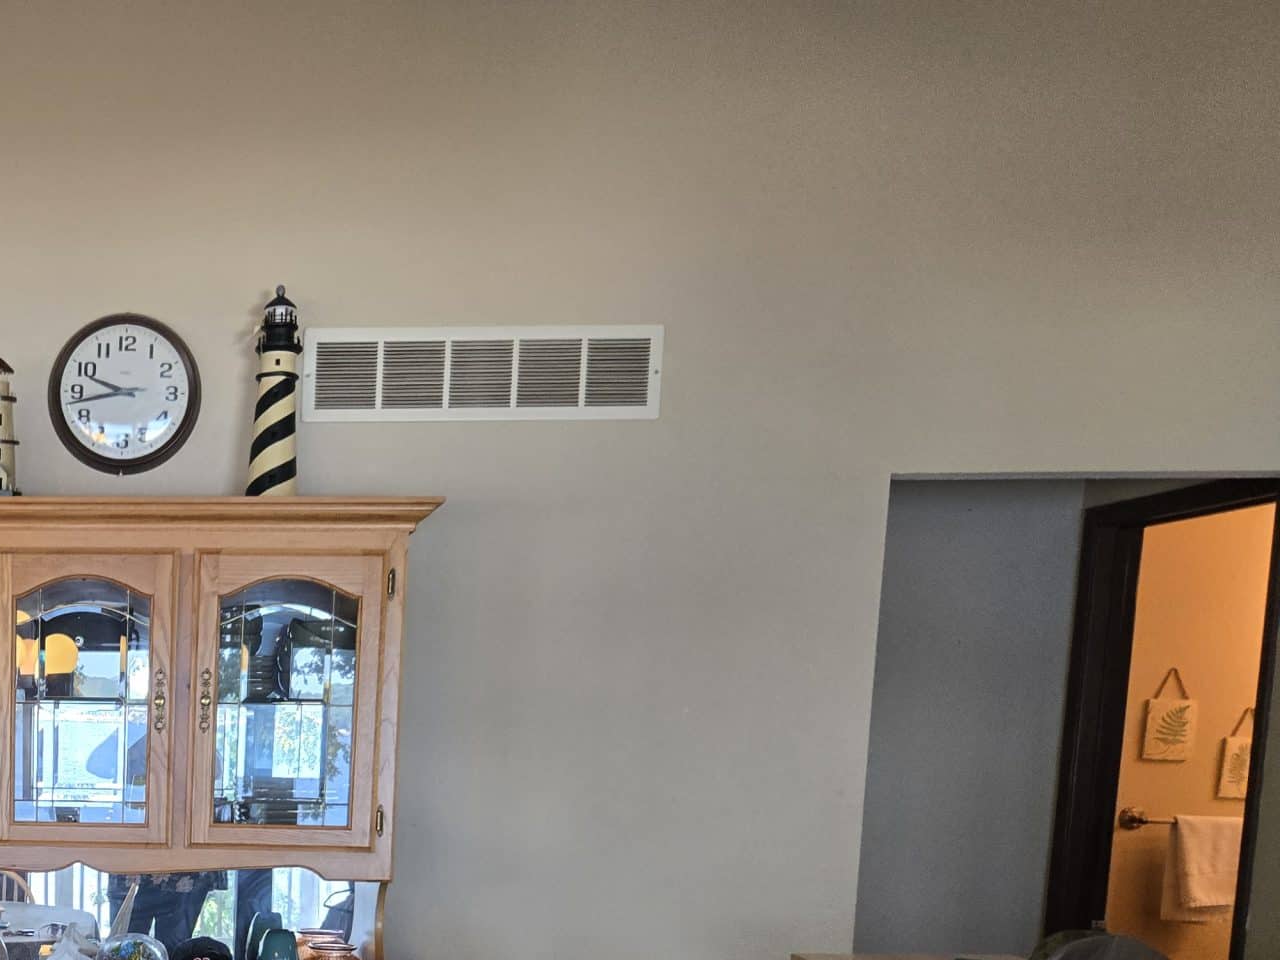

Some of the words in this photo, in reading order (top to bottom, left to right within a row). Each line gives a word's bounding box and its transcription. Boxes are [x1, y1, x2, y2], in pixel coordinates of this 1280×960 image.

[97, 342, 110, 359] 11
[118, 335, 137, 352] 12
[149, 343, 154, 359] 1
[77, 361, 97, 378] 10
[159, 362, 173, 378] 2
[70, 383, 84, 400] 9
[165, 385, 179, 402] 3
[77, 408, 91, 425] 8
